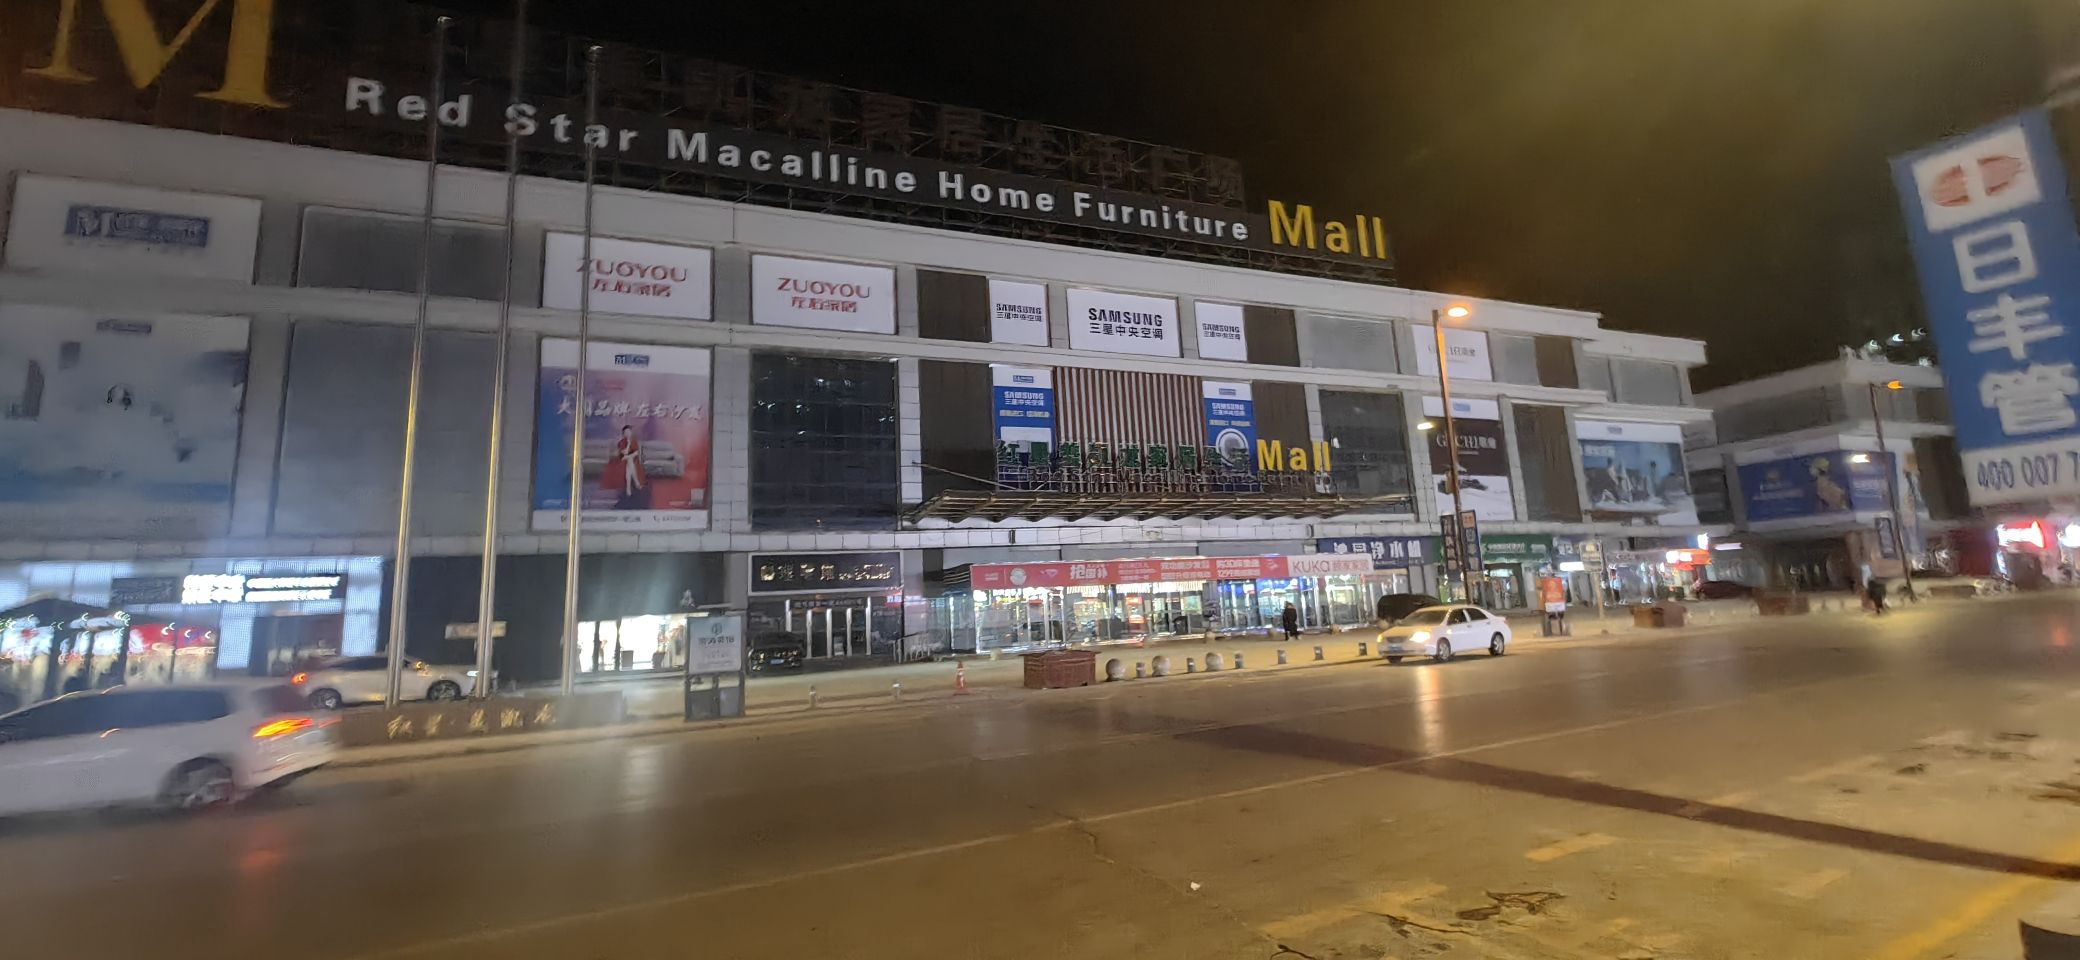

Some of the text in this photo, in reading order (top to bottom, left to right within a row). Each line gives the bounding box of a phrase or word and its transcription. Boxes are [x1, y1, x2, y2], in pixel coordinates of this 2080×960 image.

[22, 0, 291, 108] M
[345, 76, 1389, 261] Red Star Macalline Home Furniture Mall
[576, 257, 689, 283] ZUOYOU
[777, 276, 871, 299] ZUOYOU
[996, 303, 1042, 315] SAMSUNG
[1088, 307, 1163, 327] SAMSUNG
[1089, 322, 1163, 341] 三星中央空调
[1202, 322, 1240, 334] SAMSUNG
[1953, 219, 2080, 437] 日丰管
[1004, 391, 1044, 400] SAMSUNG
[1436, 430, 1478, 448] GCHI
[1256, 438, 1332, 472] Mall
[2020, 453, 2059, 487] 007
